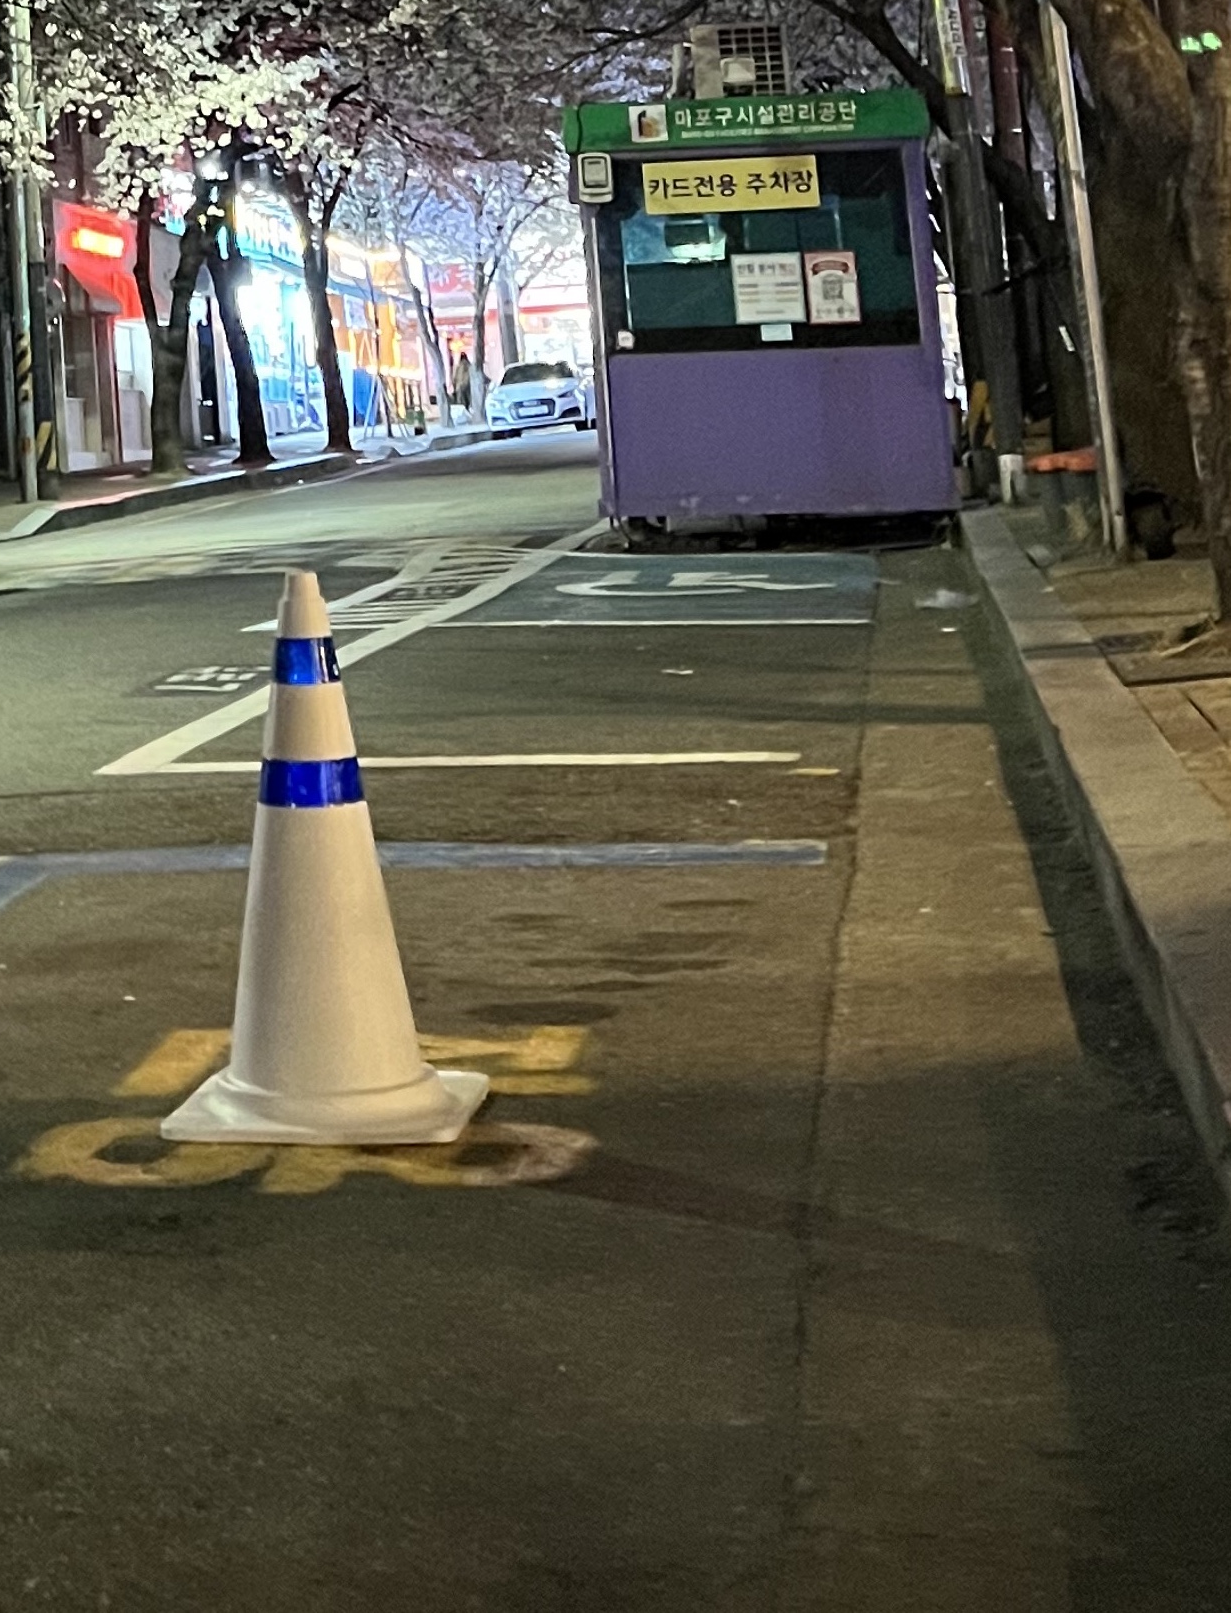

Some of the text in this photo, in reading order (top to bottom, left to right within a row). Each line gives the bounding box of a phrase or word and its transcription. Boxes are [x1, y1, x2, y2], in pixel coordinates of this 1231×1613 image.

[674, 99, 857, 128] 마포구시설관리공단
[648, 169, 814, 200] 카드전용 주차장
